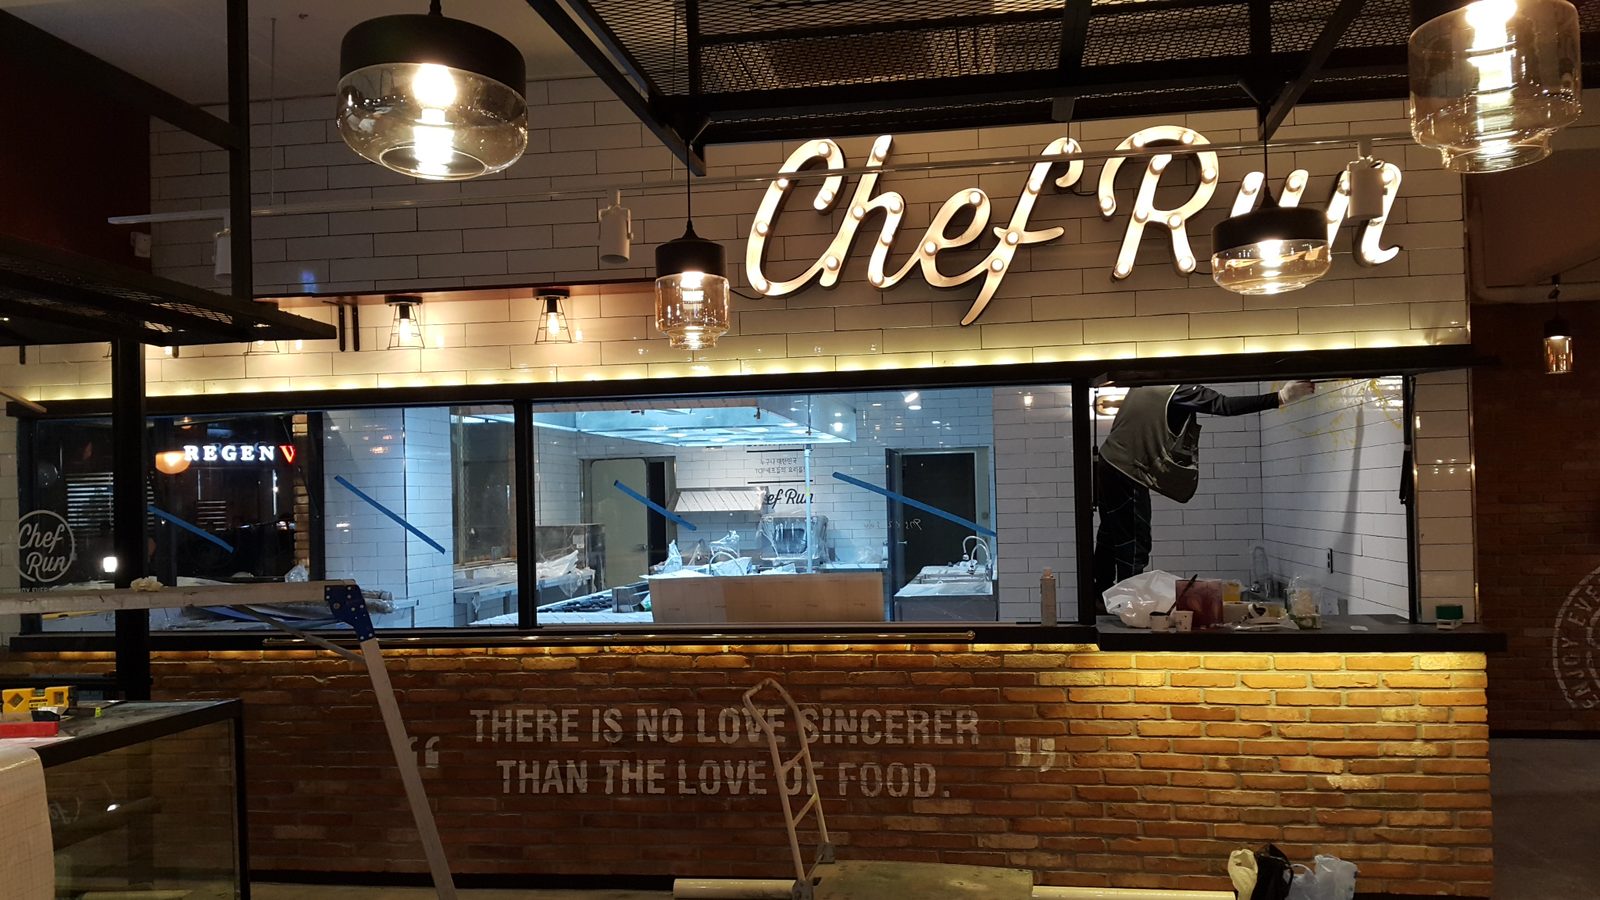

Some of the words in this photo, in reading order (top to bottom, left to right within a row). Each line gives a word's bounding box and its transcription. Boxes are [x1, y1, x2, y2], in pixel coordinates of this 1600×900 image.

[745, 134, 1084, 326] Chef
[18, 522, 66, 554] Chef
[26, 551, 66, 575] Run
[470, 709, 579, 742] THERE
[592, 707, 623, 743] IS
[636, 708, 684, 743] NO
[696, 706, 786, 744] LOVE
[800, 708, 980, 745] SINCERER
[496, 759, 589, 795] THAN
[599, 758, 666, 795] THE
[677, 758, 767, 796] LOVE
[780, 761, 824, 796] OF
